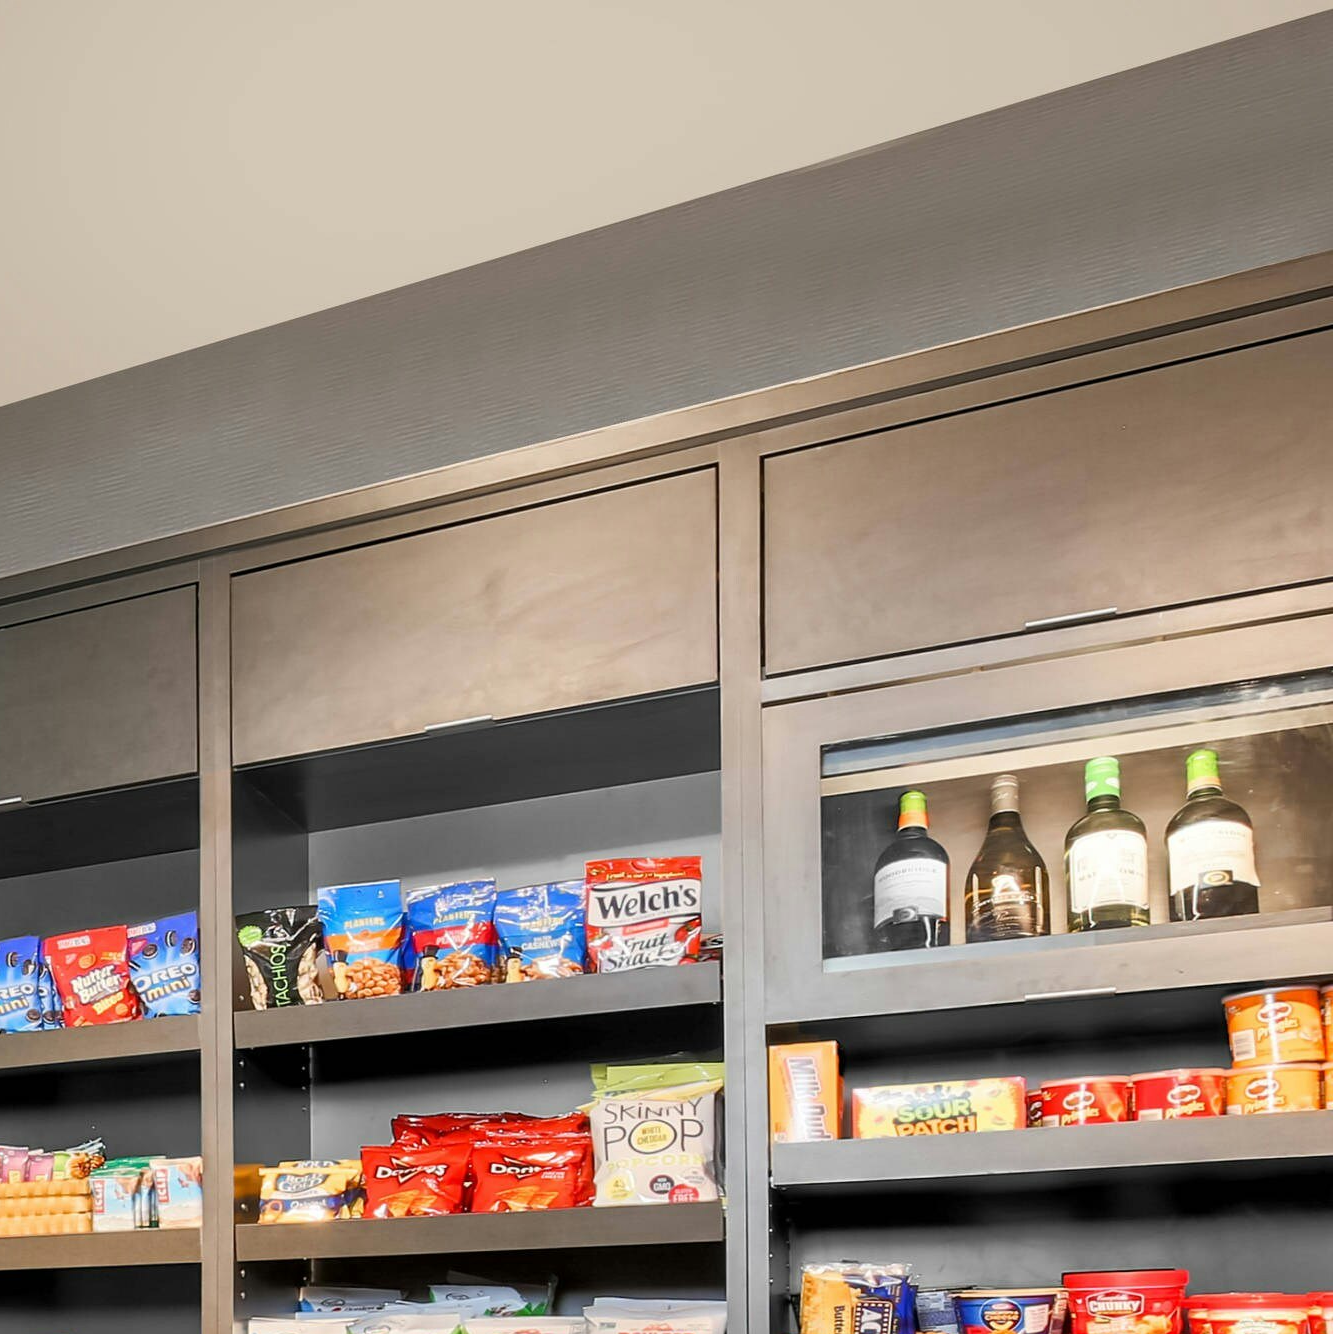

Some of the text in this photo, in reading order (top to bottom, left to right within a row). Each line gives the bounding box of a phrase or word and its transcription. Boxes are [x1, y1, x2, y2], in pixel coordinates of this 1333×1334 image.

[596, 884, 697, 920] Welch's
[624, 933, 668, 952] Fruit
[71, 965, 115, 993] Nutter
[78, 974, 123, 1004] Butter
[134, 962, 196, 992] OREO
[147, 977, 191, 1002] mini
[787, 1057, 821, 1101] Milk
[604, 1097, 703, 1125] SKINNY
[897, 1098, 972, 1123] SOUR
[894, 1114, 978, 1136] PATCH
[604, 1119, 703, 1161] POP
[376, 1163, 449, 1180] Doritos
[607, 1154, 707, 1170] POPCORN
[654, 1182, 672, 1192] GMO
[1089, 1301, 1142, 1312] CHUNKY
